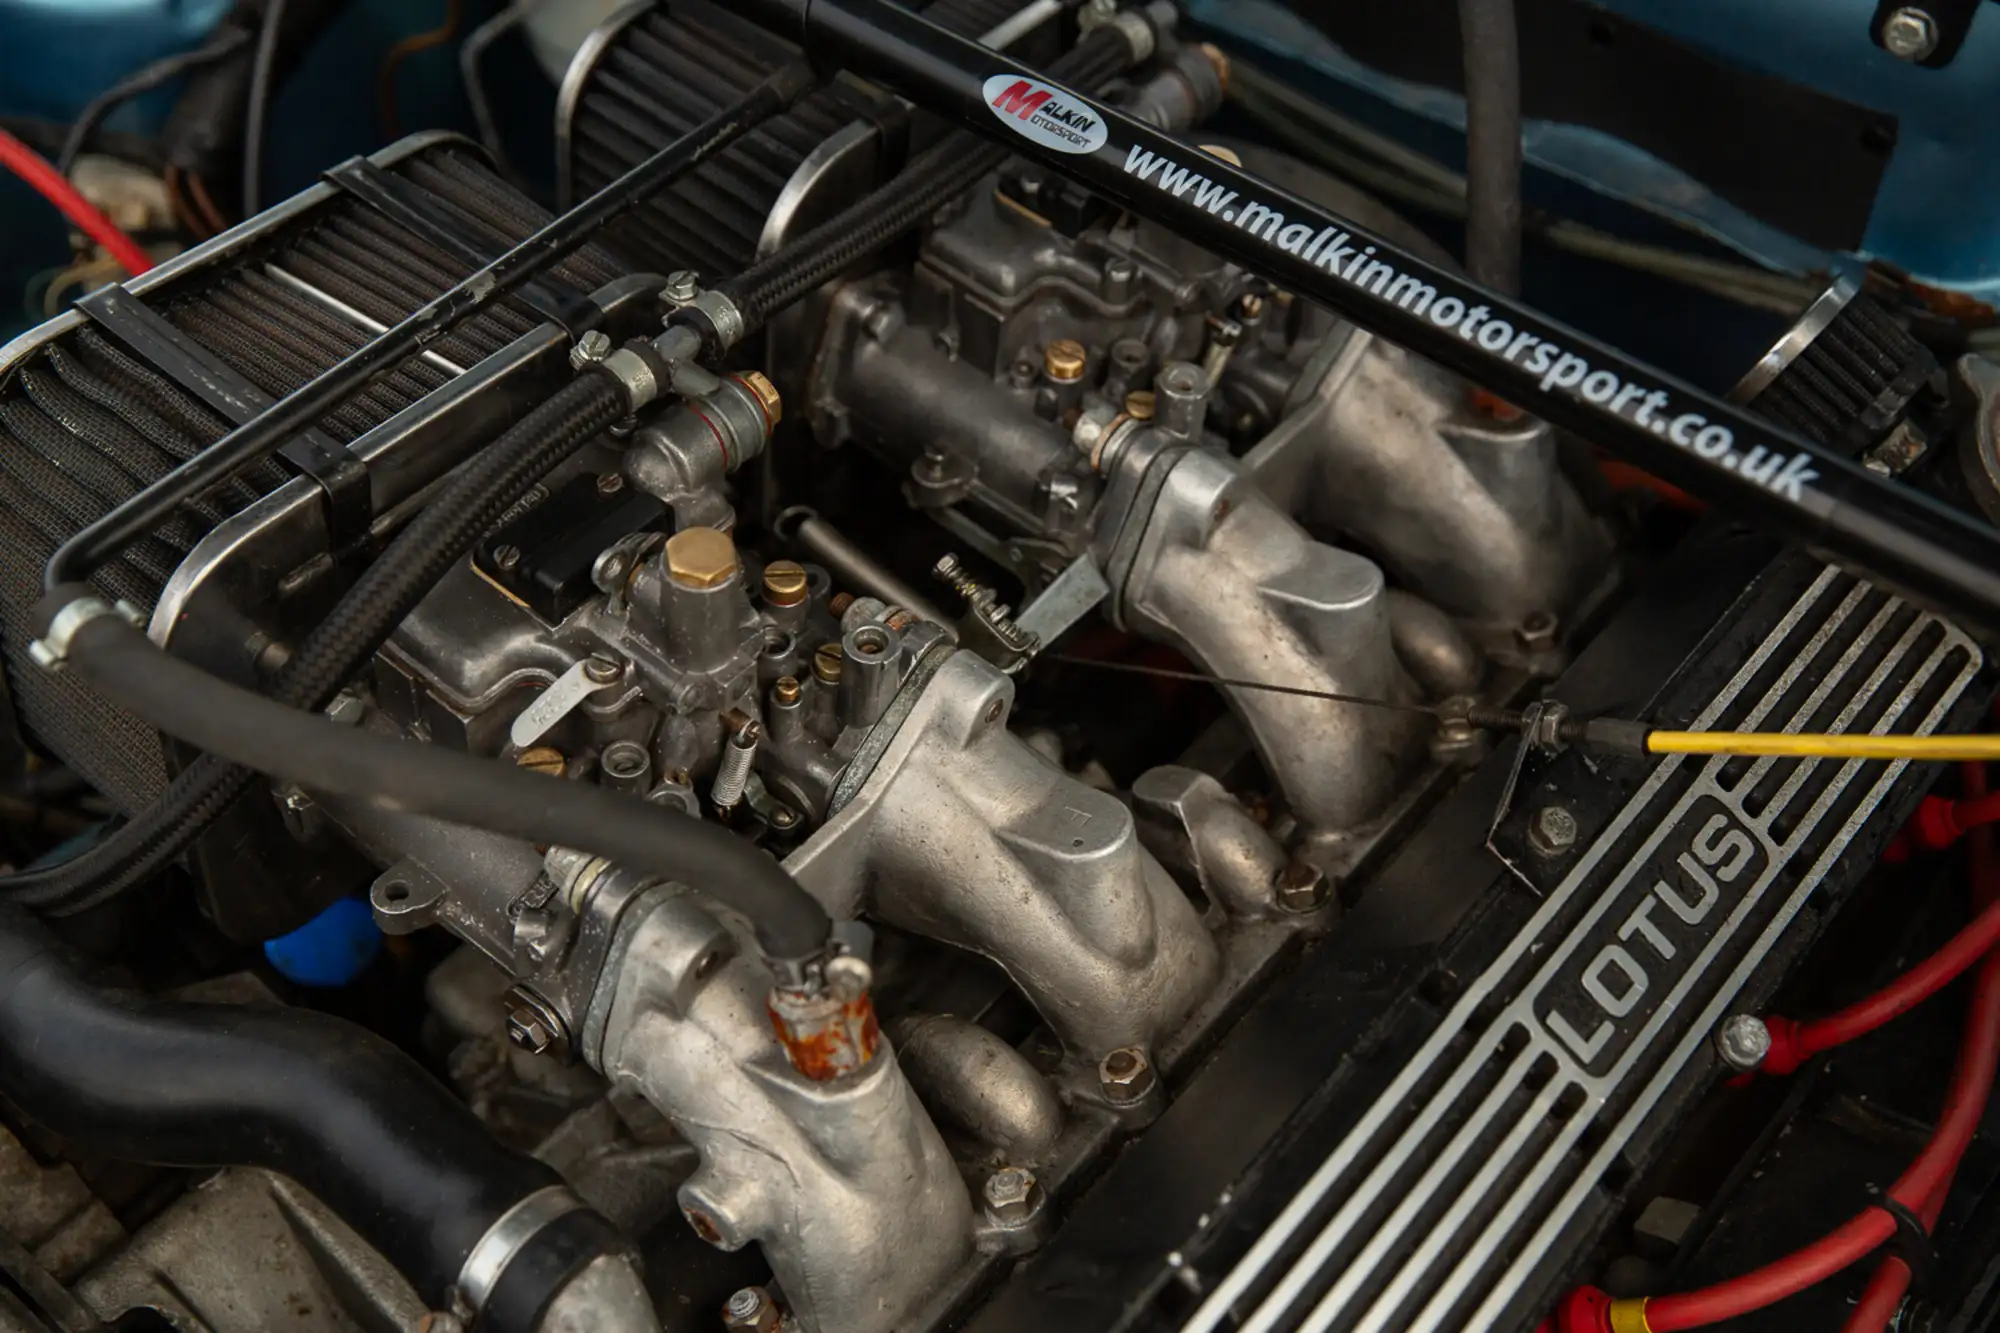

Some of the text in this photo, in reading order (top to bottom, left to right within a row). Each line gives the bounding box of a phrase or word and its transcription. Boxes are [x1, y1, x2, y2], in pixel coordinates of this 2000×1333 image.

[992, 80, 1096, 133] MALKIN
[1123, 144, 1820, 502] www.malkinmotorsport.co.uk
[1546, 813, 1755, 1065] LOTUS
